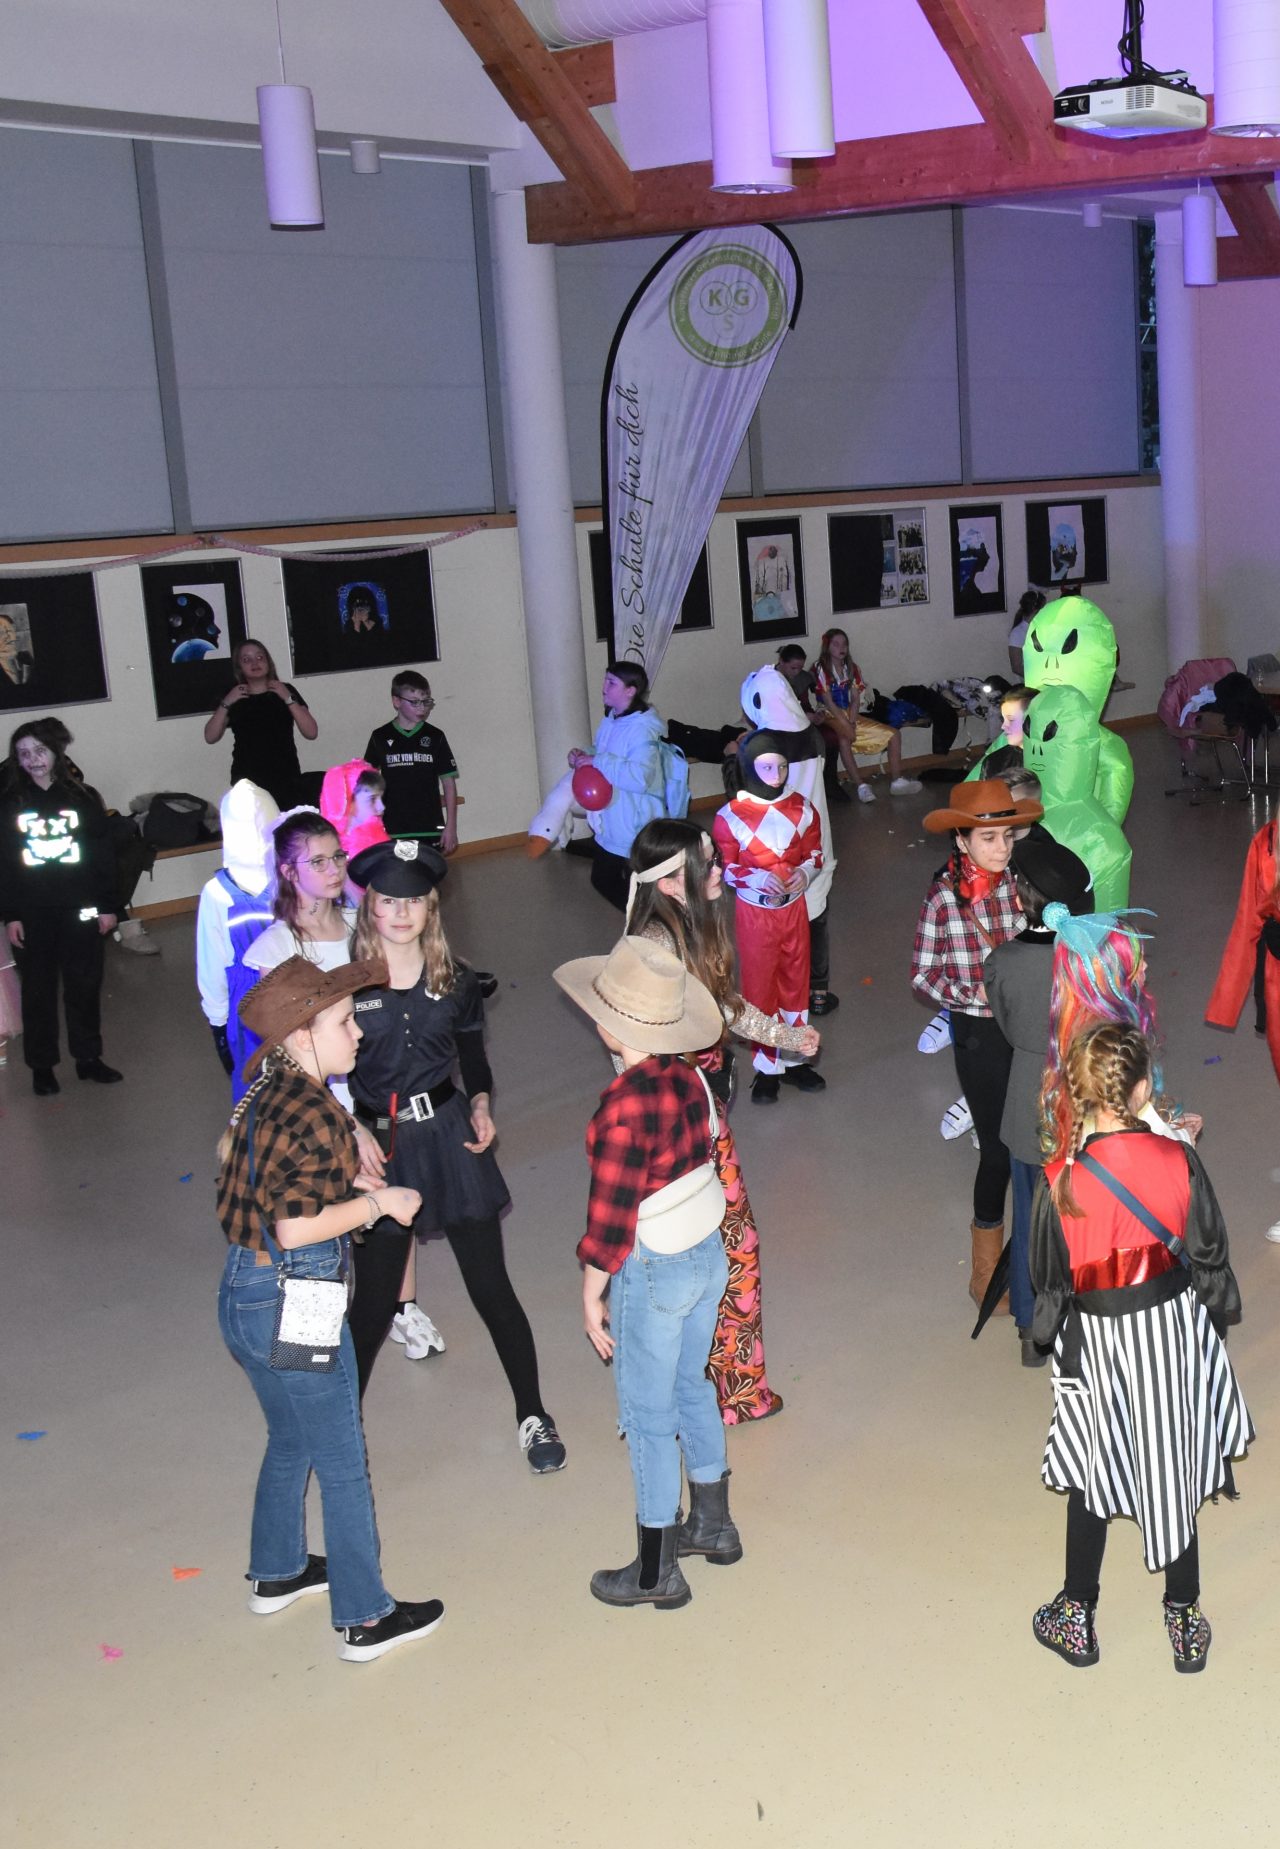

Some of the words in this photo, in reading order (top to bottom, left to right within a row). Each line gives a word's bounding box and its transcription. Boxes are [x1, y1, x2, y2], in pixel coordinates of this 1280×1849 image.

[708, 288, 722, 307] K
[733, 288, 749, 306] G
[722, 314, 735, 331] S
[615, 382, 644, 447] dich
[617, 452, 653, 506] für
[618, 509, 645, 616] Schule
[355, 1000, 380, 1011] POLICE
